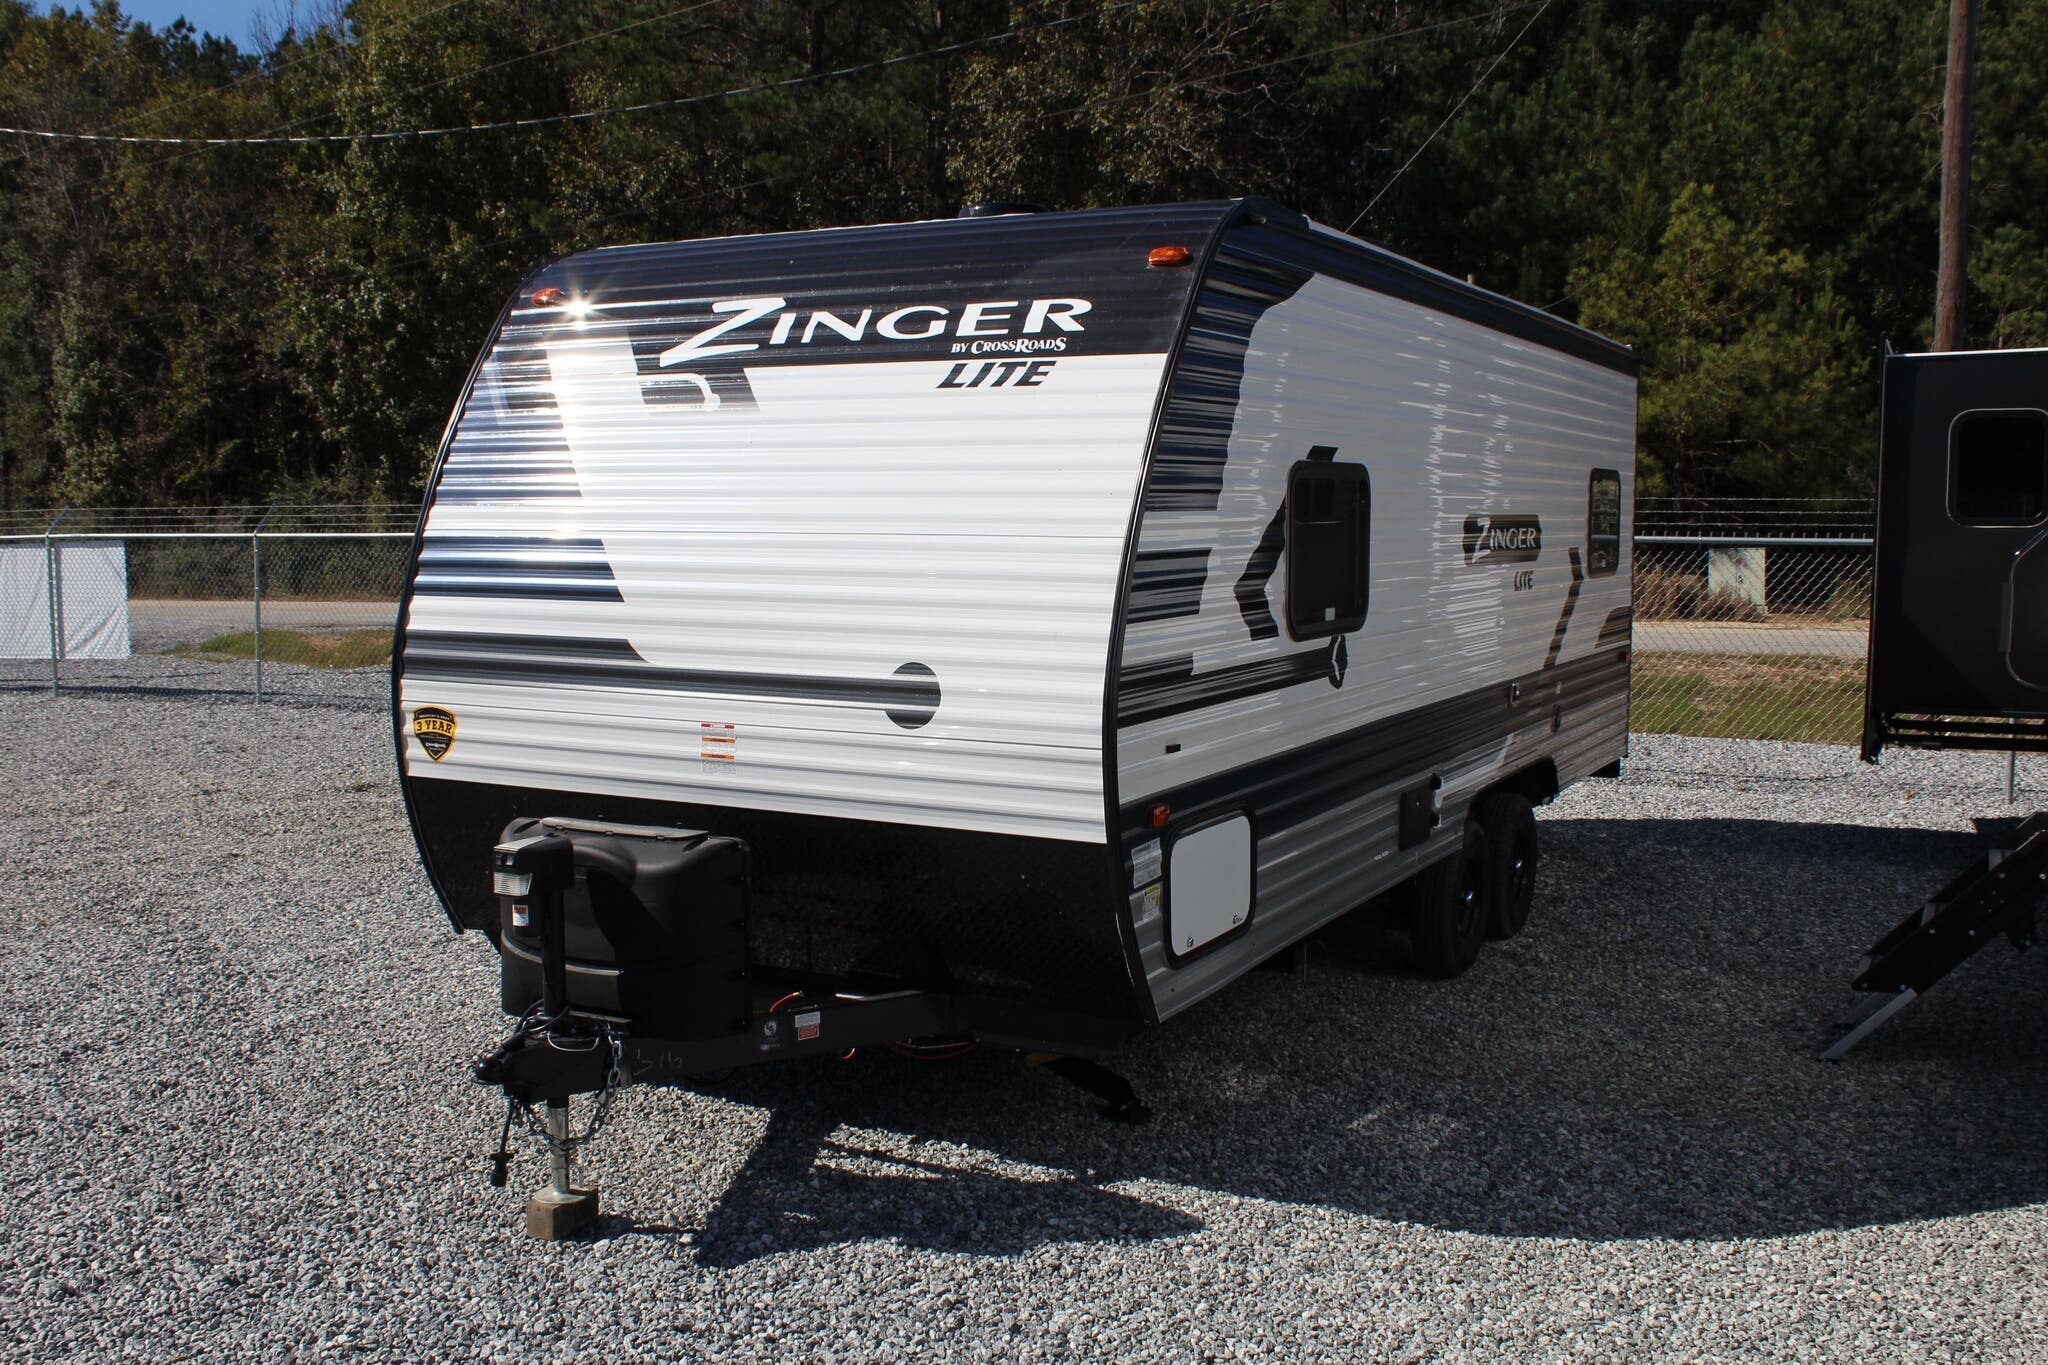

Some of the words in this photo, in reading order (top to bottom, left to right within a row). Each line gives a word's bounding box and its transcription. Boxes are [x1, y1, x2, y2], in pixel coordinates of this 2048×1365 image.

[659, 297, 1092, 368] ZINGER
[951, 342, 968, 354] BY
[936, 361, 1056, 389] LITE
[1472, 517, 1537, 564] ZINGER
[1514, 571, 1534, 592] LITE
[416, 721, 423, 731] 3
[425, 720, 452, 733] YEAR
